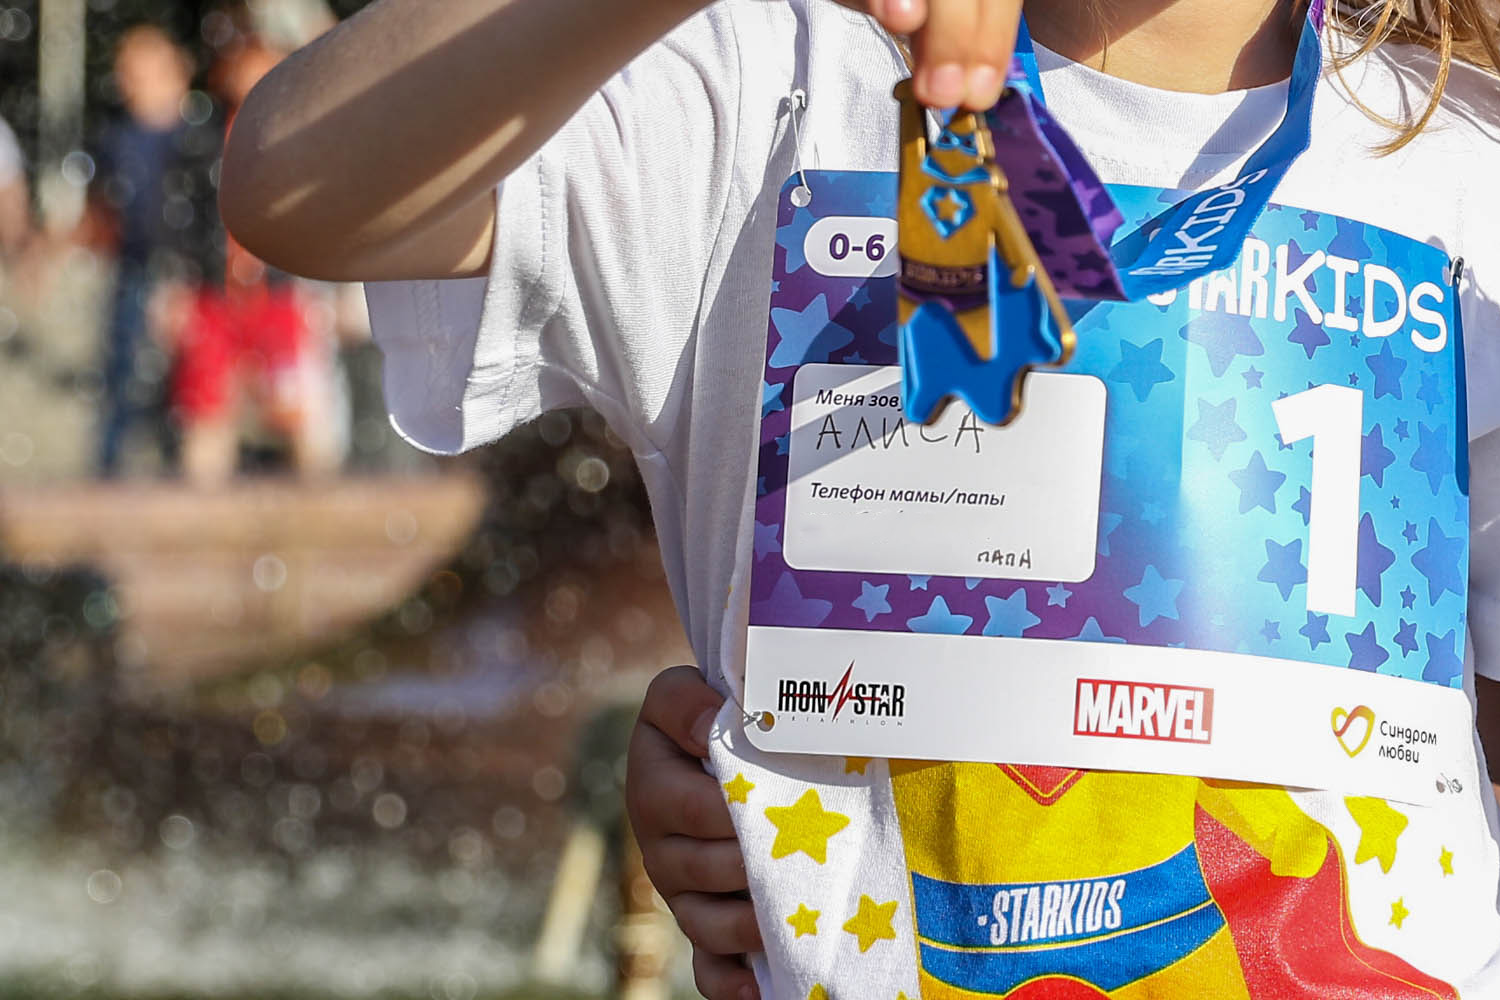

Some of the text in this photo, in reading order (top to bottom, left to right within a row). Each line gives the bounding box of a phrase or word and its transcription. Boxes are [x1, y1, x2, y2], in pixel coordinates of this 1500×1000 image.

[829, 232, 885, 262] 0-6
[816, 389, 902, 412] Меня зов
[816, 408, 984, 453] АЛИСА
[811, 482, 1005, 507] Телефон мамы/папы
[1271, 383, 1364, 618] 1
[778, 680, 905, 717] IRON STAR
[1077, 682, 1209, 741] MARVEL
[1380, 720, 1437, 745] Синдром
[1379, 745, 1420, 763] любви
[990, 879, 1126, 946] STARKIDS
